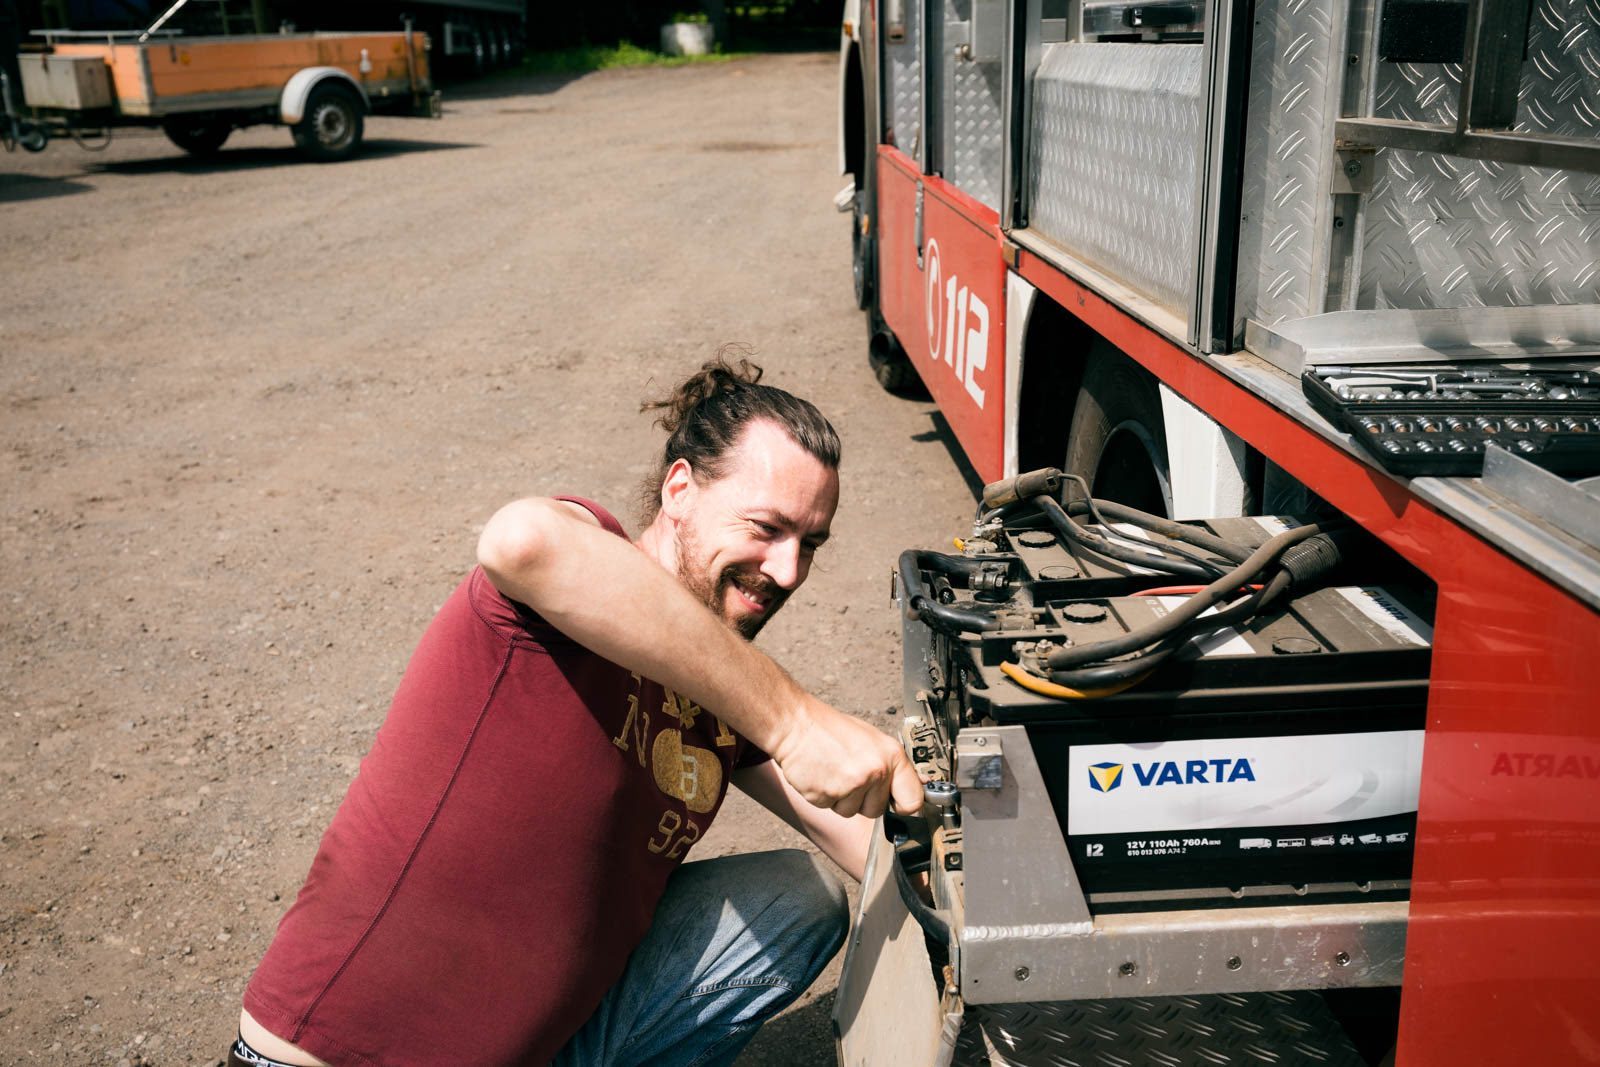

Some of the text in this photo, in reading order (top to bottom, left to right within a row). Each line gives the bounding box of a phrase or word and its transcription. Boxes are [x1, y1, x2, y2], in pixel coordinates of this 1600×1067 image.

[944, 274, 990, 411] 112
[1132, 757, 1256, 787] VARTA
[1126, 840, 1147, 850] 12V
[1149, 839, 1180, 849] 110Ah
